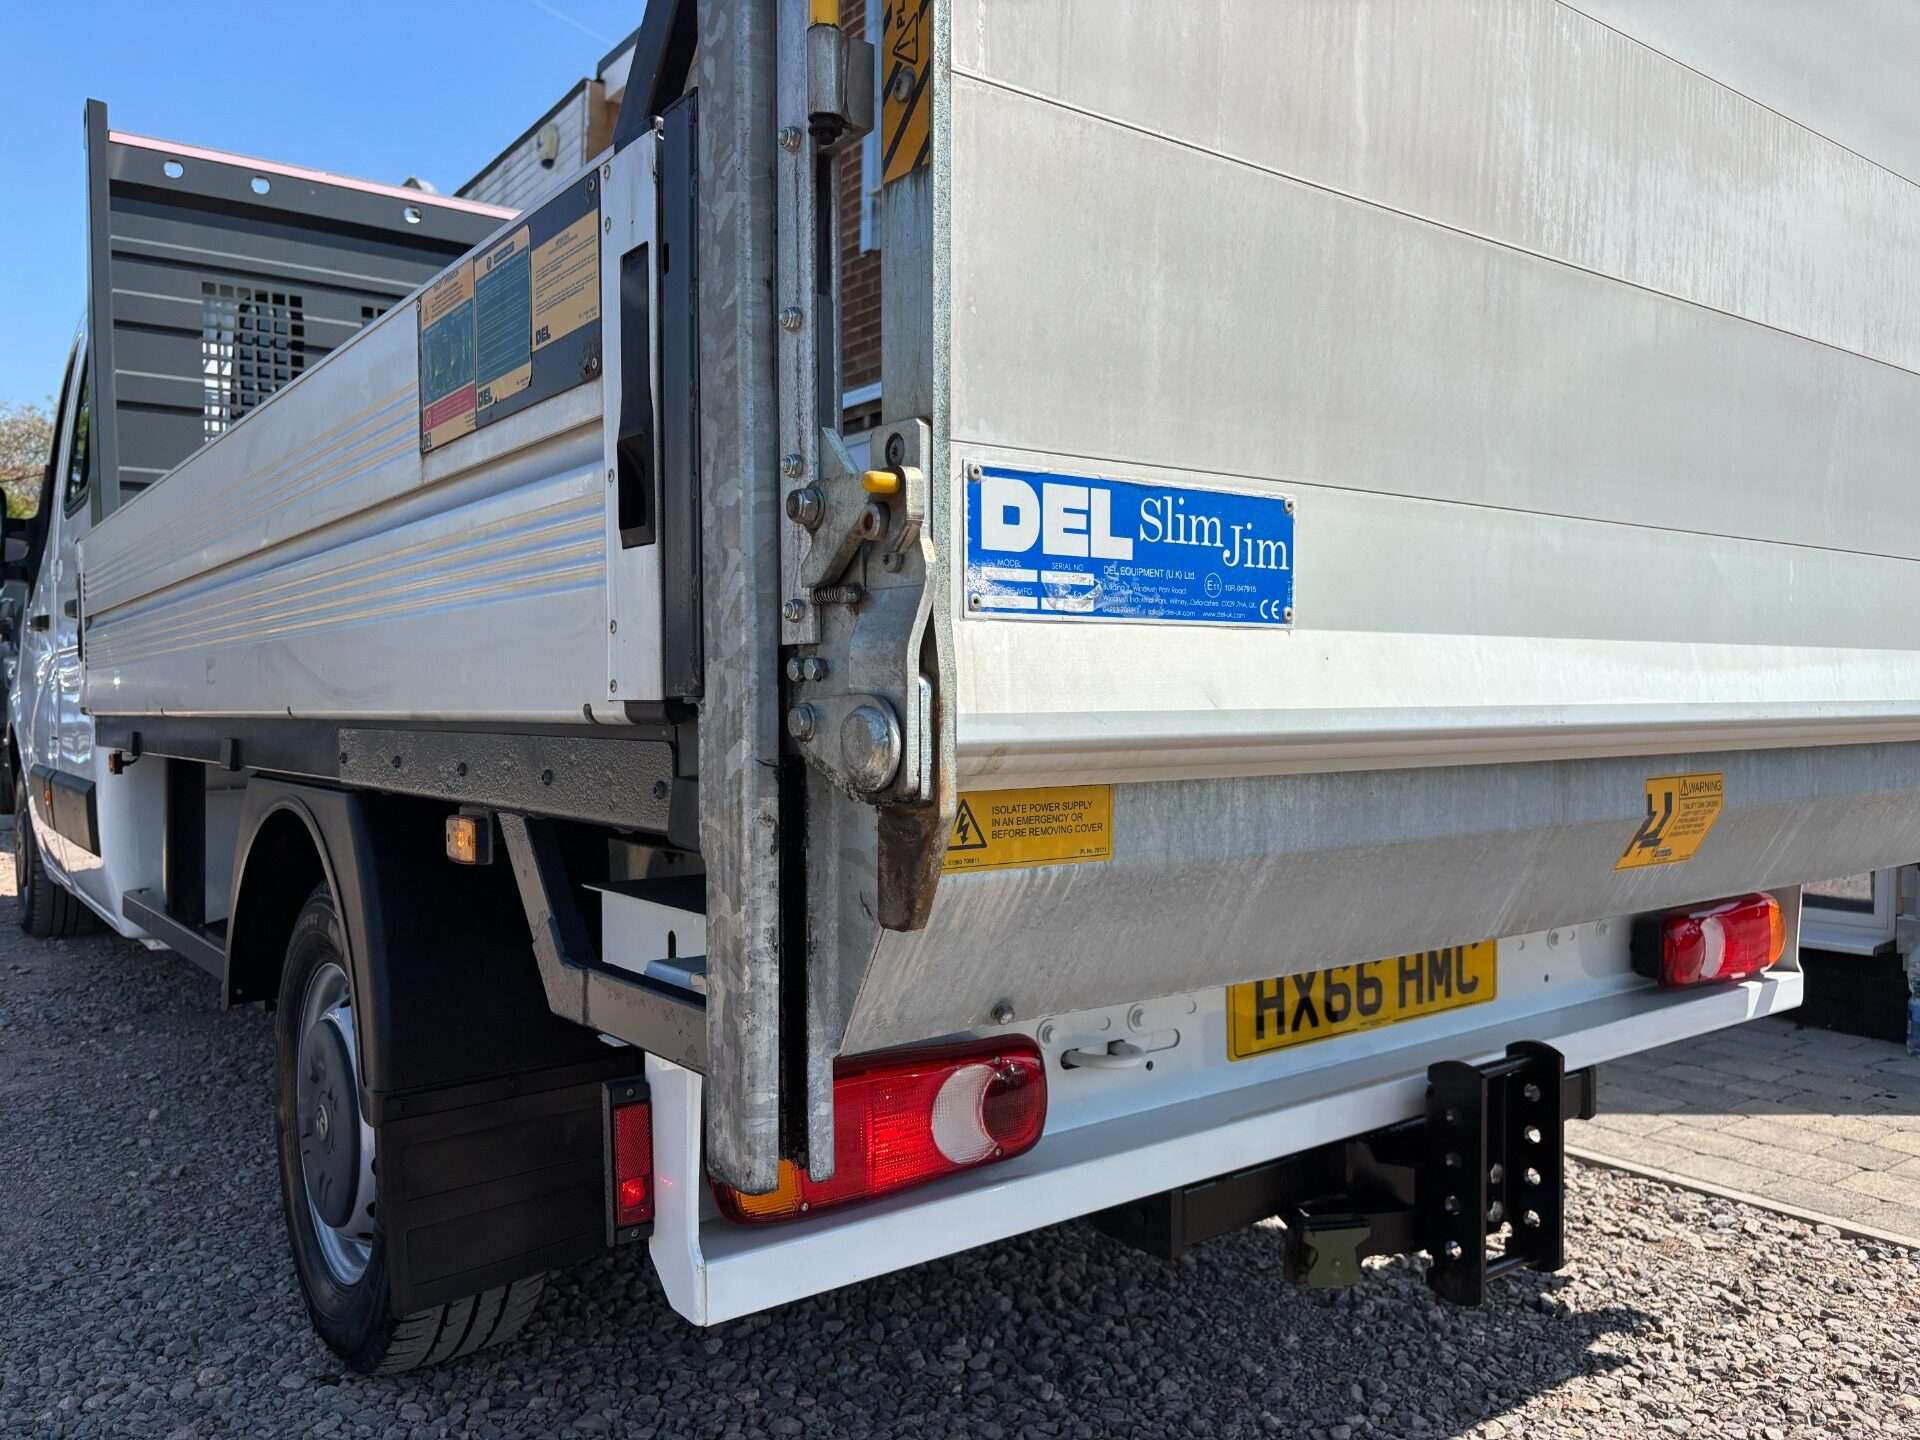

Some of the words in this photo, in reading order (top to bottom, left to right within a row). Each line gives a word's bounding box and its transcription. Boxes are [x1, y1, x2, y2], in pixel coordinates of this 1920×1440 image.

[981, 475, 1134, 561] DEL
[1140, 496, 1225, 549] Slim
[1223, 522, 1289, 570] Jim
[1052, 562, 1072, 570] SERIAL
[1103, 565, 1119, 575] DEL
[1120, 566, 1165, 578] EQUIPMENT
[1688, 779, 1722, 794] WARNING
[991, 804, 1027, 816] ISOLATE
[1029, 802, 1060, 813] POWER
[1062, 800, 1094, 811] SUPPLY
[991, 817, 1001, 827] IN
[1002, 816, 1014, 826] AN
[1016, 813, 1069, 826] EMERGENCY
[1071, 812, 1083, 822] OR
[991, 828, 1027, 840] BEFORE
[1028, 825, 1073, 837] REMOVING
[1075, 822, 1103, 833] COVER
[1255, 958, 1384, 1041] HX66
[1397, 941, 1480, 1009] HMC
